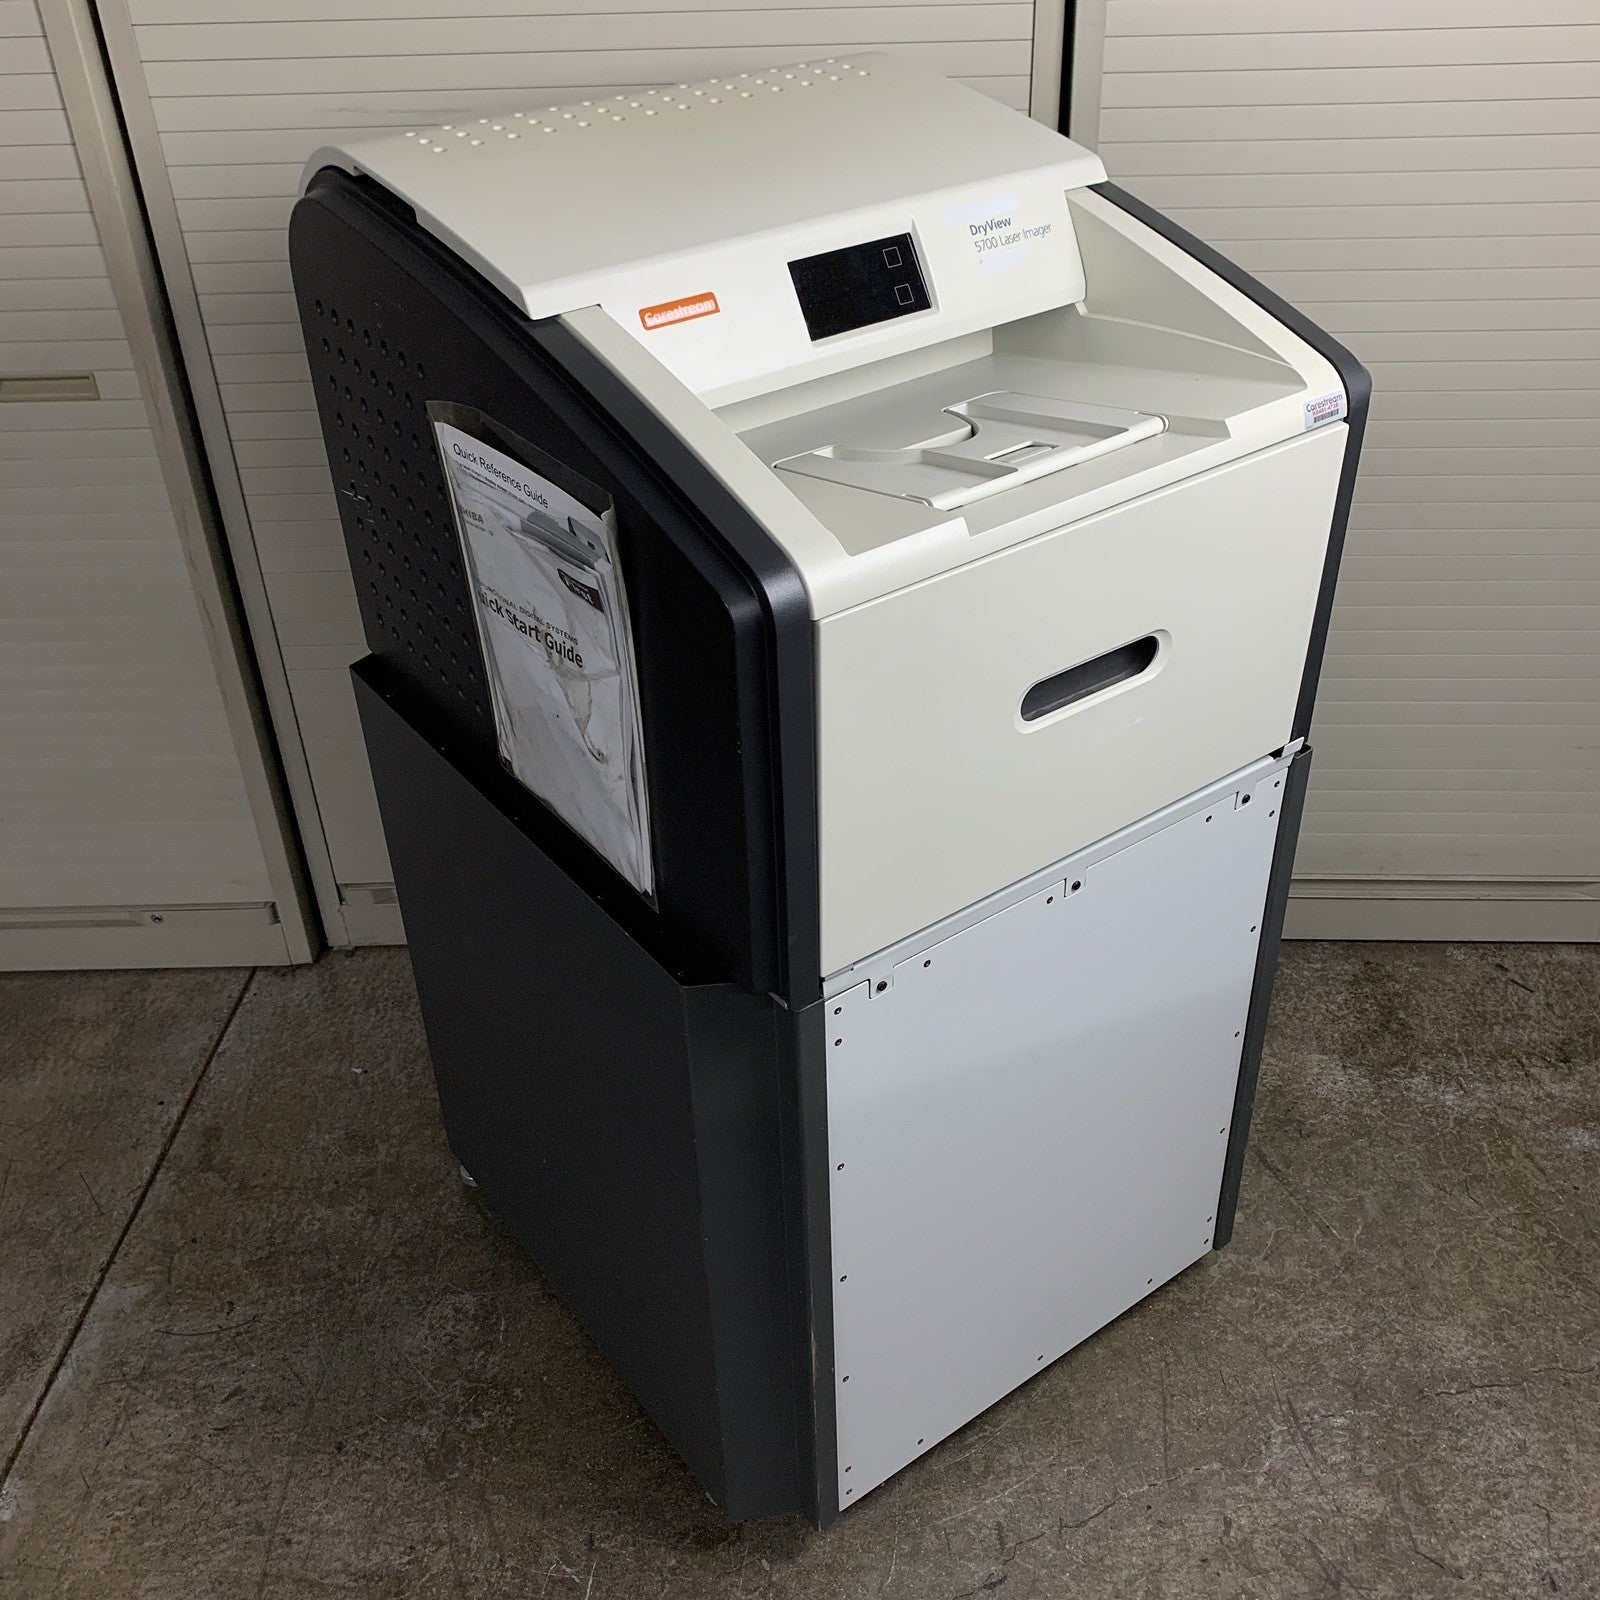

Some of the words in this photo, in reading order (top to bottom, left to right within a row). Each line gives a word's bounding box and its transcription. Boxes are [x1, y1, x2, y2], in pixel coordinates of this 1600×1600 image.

[969, 217, 1012, 236] DryView
[974, 236, 999, 253] 5700
[999, 231, 1021, 246] Laser
[1022, 223, 1053, 239] Imager
[644, 299, 716, 328] Carestream
[1306, 394, 1343, 412] Carestream
[453, 443, 479, 465] Quick
[479, 456, 522, 491] Reference
[523, 484, 549, 508] Guide
[505, 608, 541, 643] Start
[545, 632, 583, 668] Guide
[545, 622, 579, 645] SYSTEMS
